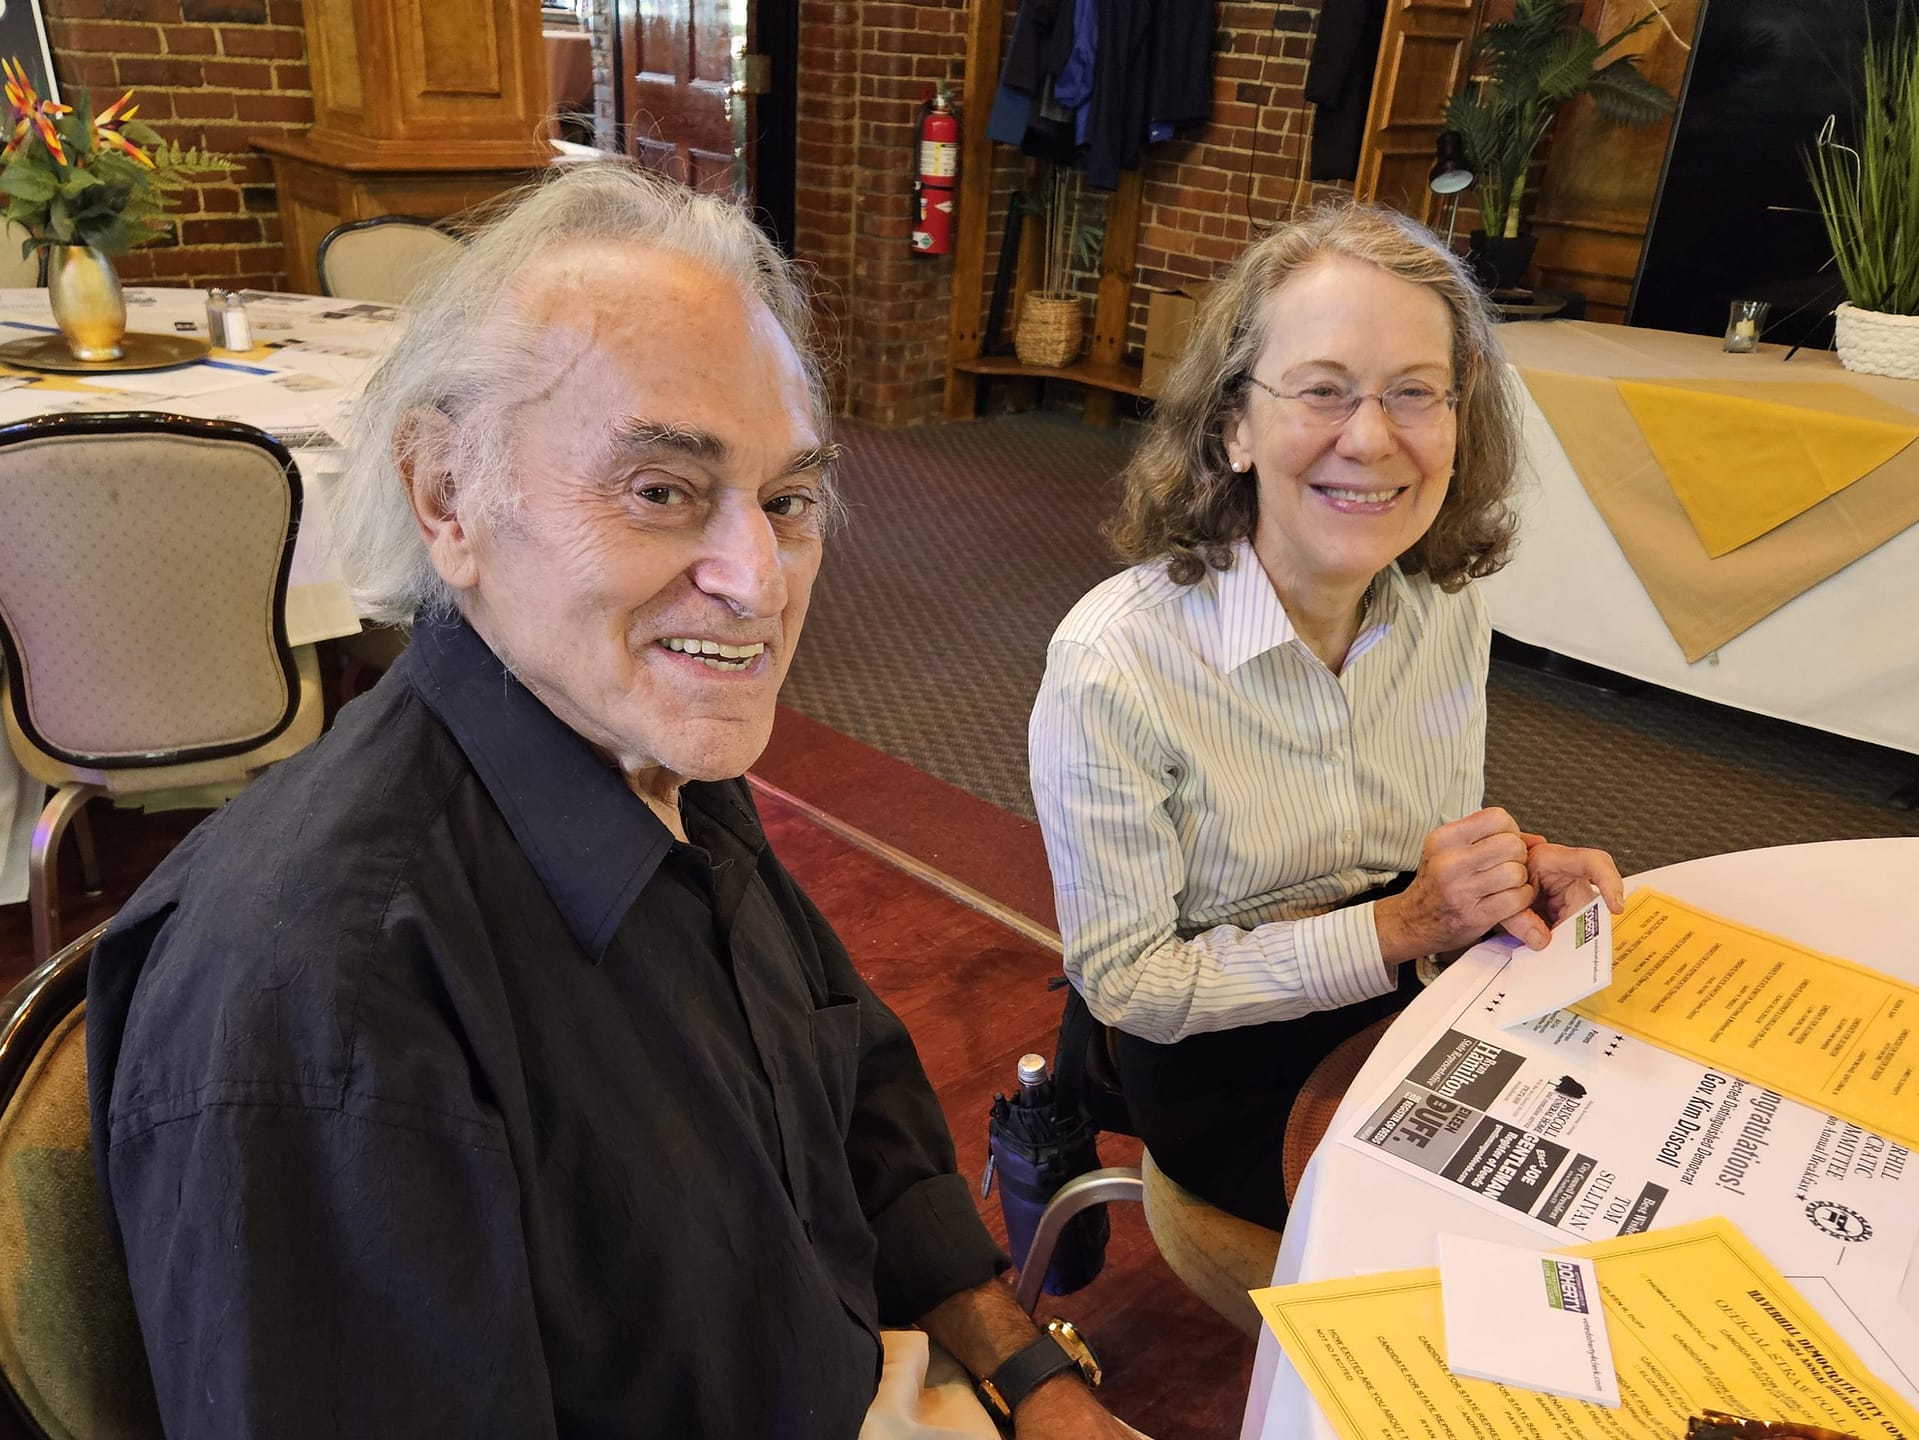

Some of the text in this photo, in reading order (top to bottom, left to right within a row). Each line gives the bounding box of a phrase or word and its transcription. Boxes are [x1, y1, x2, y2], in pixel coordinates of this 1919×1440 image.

[1424, 1038, 1472, 1087] State Representative
[1438, 1041, 1501, 1098] Hamilton
[1472, 1056, 1497, 1076] Ryan
[1370, 1099, 1414, 1144] REGISTER OF DEEDS
[1443, 1106, 1473, 1134] EILEEN
[1542, 1098, 1580, 1140] DRISCOLL
[1654, 1071, 1727, 1171] Gov. Kim Driscoll
[1696, 1097, 1737, 1150] Distinguished
[1488, 1130, 1519, 1160] Register
[1813, 1125, 1838, 1156] Annual
[1852, 1132, 1887, 1180] CRATIC
[1469, 1165, 1494, 1188] Deeds
[1479, 1131, 1542, 1199] GENTLEMAN
[1485, 1157, 1499, 1168] of
[1518, 1149, 1547, 1186] Elect JOE
[1563, 1172, 1585, 1194] Council
[1576, 1161, 1592, 1174] City
[1678, 1146, 1712, 1188] Democrat
[1796, 1153, 1827, 1195] Breakfast
[1878, 1142, 1910, 1184] RHILL
[1546, 1192, 1573, 1220] President
[1564, 1169, 1619, 1231] SULLIVAN
[1601, 1194, 1632, 1224] TOM
[1635, 1196, 1656, 1215] Best
[1557, 1262, 1582, 1313] DOHERTY
[1601, 1286, 1623, 1306] EILEEN
[1626, 1313, 1646, 1329] DUFF
[1645, 1278, 1671, 1302] THOMAS
[1314, 1328, 1354, 1381] NOT SO EXCITED
[1672, 1334, 1715, 1376] CANDIDATES
[1712, 1298, 1849, 1427] OFFICIAL STRAW POLL
[1718, 1328, 1765, 1371] CANDIDATES
[1746, 1289, 1802, 1337] HAVERHILL
[1794, 1338, 1861, 1395] DEMOCRATIC
[1856, 1396, 1885, 1418] CITY
[1327, 1328, 1344, 1345] HOW
[1339, 1346, 1364, 1374] EXCITED
[1359, 1375, 1375, 1391] ARE
[1369, 1391, 1387, 1407] YOU
[1381, 1407, 1405, 1433] ABOUT
[1376, 1335, 1408, 1373] CANDIDATE
[1403, 1374, 1420, 1389] FOR
[1415, 1390, 1437, 1412] STATE
[1417, 1335, 1450, 1372] CANDIDATE
[1445, 1373, 1463, 1388] FOR
[1458, 1389, 1479, 1411] STATE
[1639, 1356, 1679, 1395] CANDIDATE
[1780, 1338, 1871, 1422] 2024 ANNUAL BREAKFAST
[1417, 1418, 1437, 1438] RYAN
[1506, 1397, 1530, 1420] STATE
